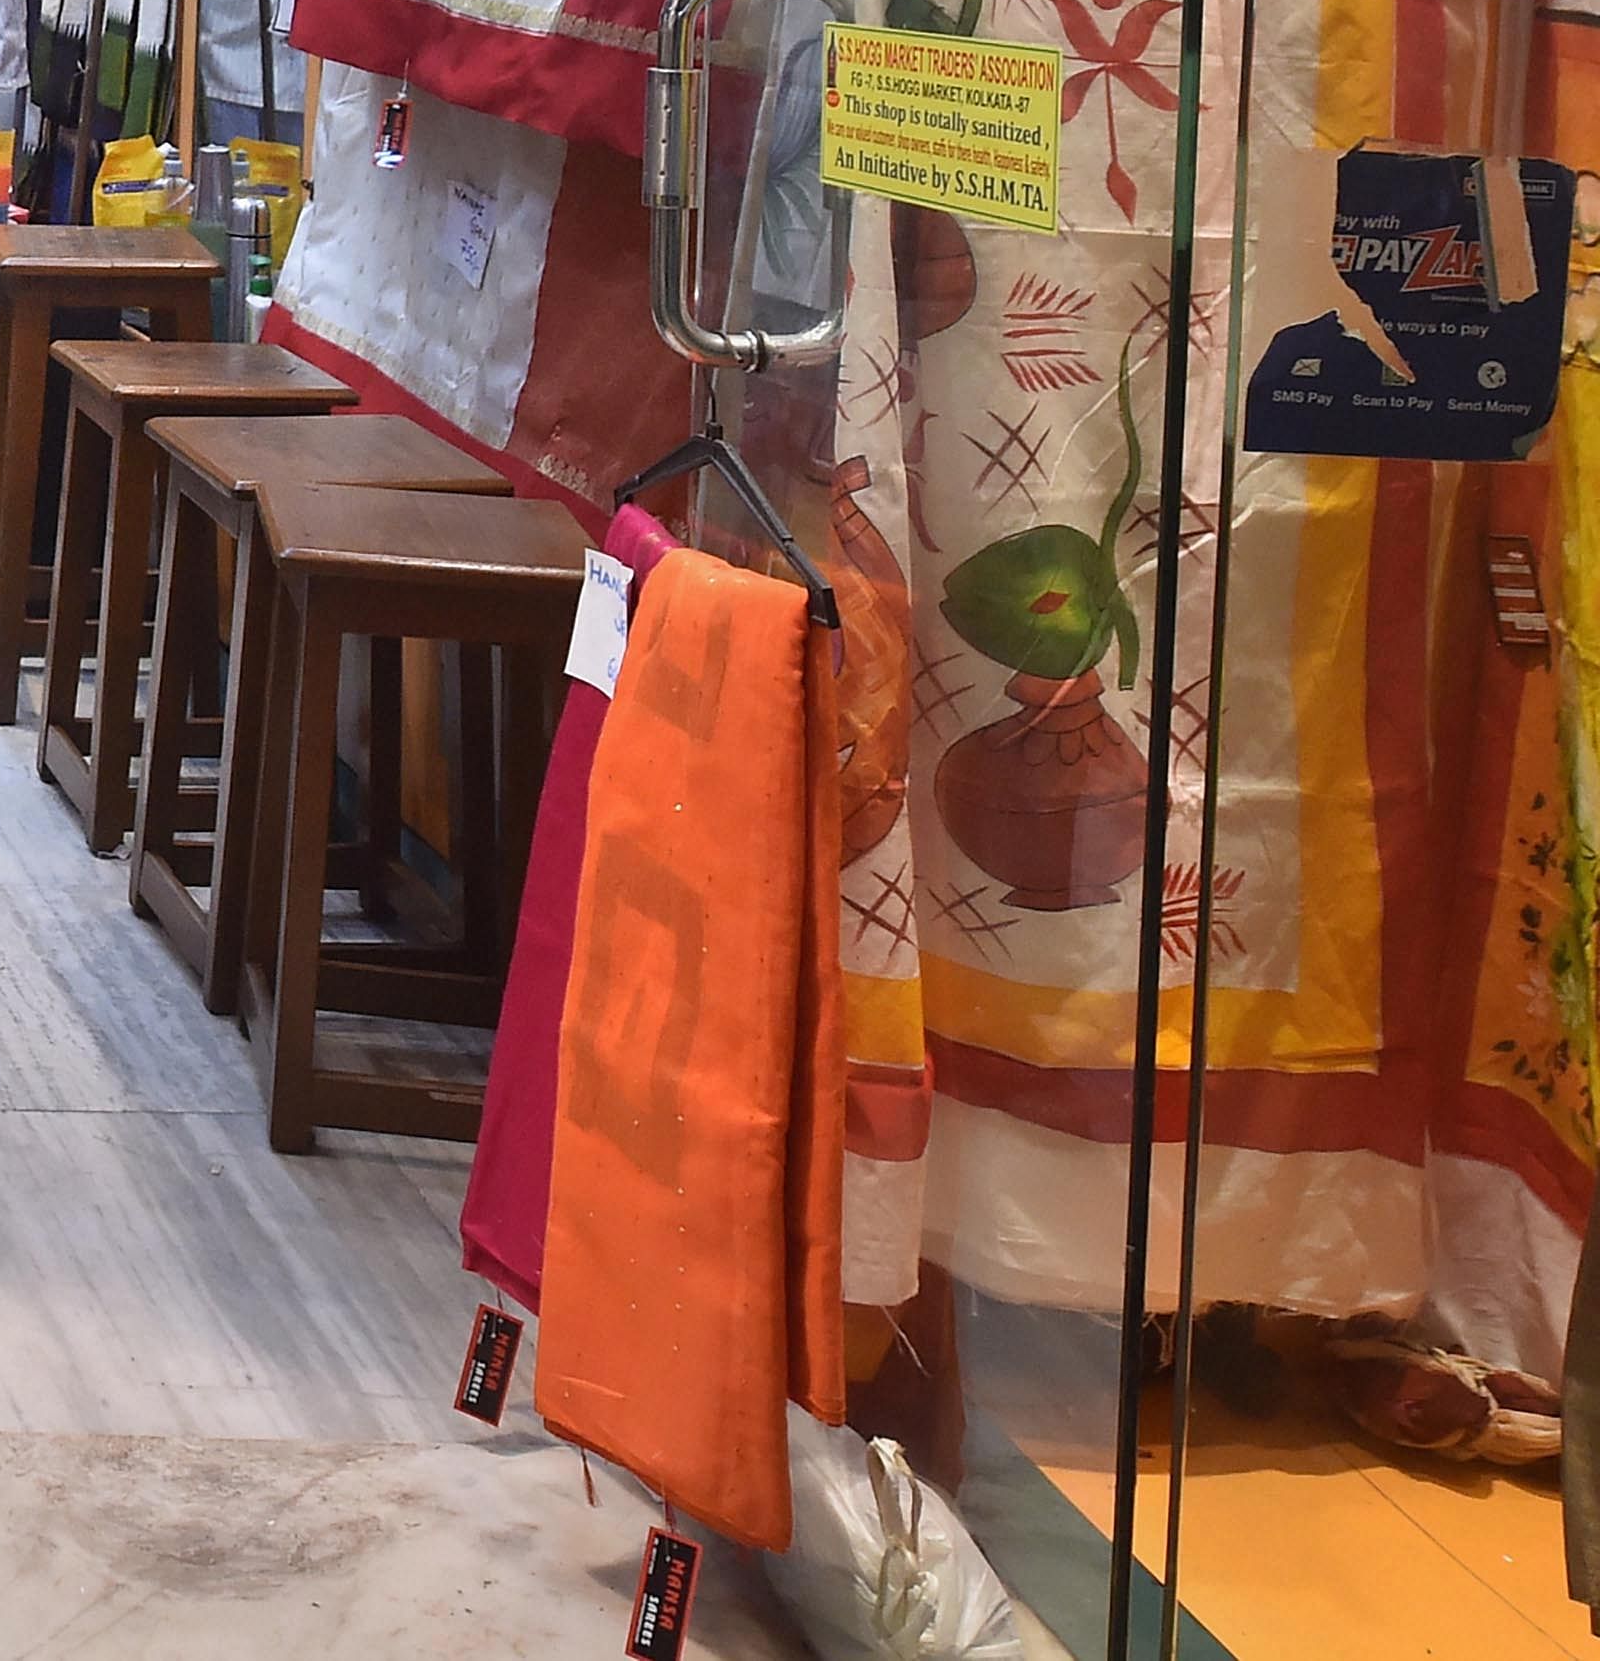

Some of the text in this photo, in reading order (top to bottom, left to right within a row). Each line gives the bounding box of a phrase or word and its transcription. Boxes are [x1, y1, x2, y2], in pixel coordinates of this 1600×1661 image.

[884, 43, 925, 73] MARKET
[980, 55, 1055, 92] ASSOCIATION
[966, 88, 1012, 111] KOLKATA
[844, 94, 871, 117] This
[874, 99, 906, 127] shop
[910, 105, 921, 125] is
[924, 108, 969, 138] totally
[972, 119, 1041, 146] sanitized
[835, 146, 854, 169] An
[859, 150, 927, 185] Initiative
[932, 163, 950, 196] by
[1525, 184, 1550, 195] ANK
[1363, 214, 1400, 230] with
[1397, 323, 1437, 337] ways
[1441, 322, 1456, 335] to
[1461, 325, 1490, 338] pay
[1272, 389, 1334, 408] SMS Pay
[1352, 394, 1434, 413] Scan to Pay
[1447, 398, 1532, 417] Send Money
[484, 1332, 512, 1391] MANSA
[467, 1361, 486, 1404] SAREES
[659, 1558, 687, 1631] MANSA
[640, 1595, 660, 1648] SAREES
